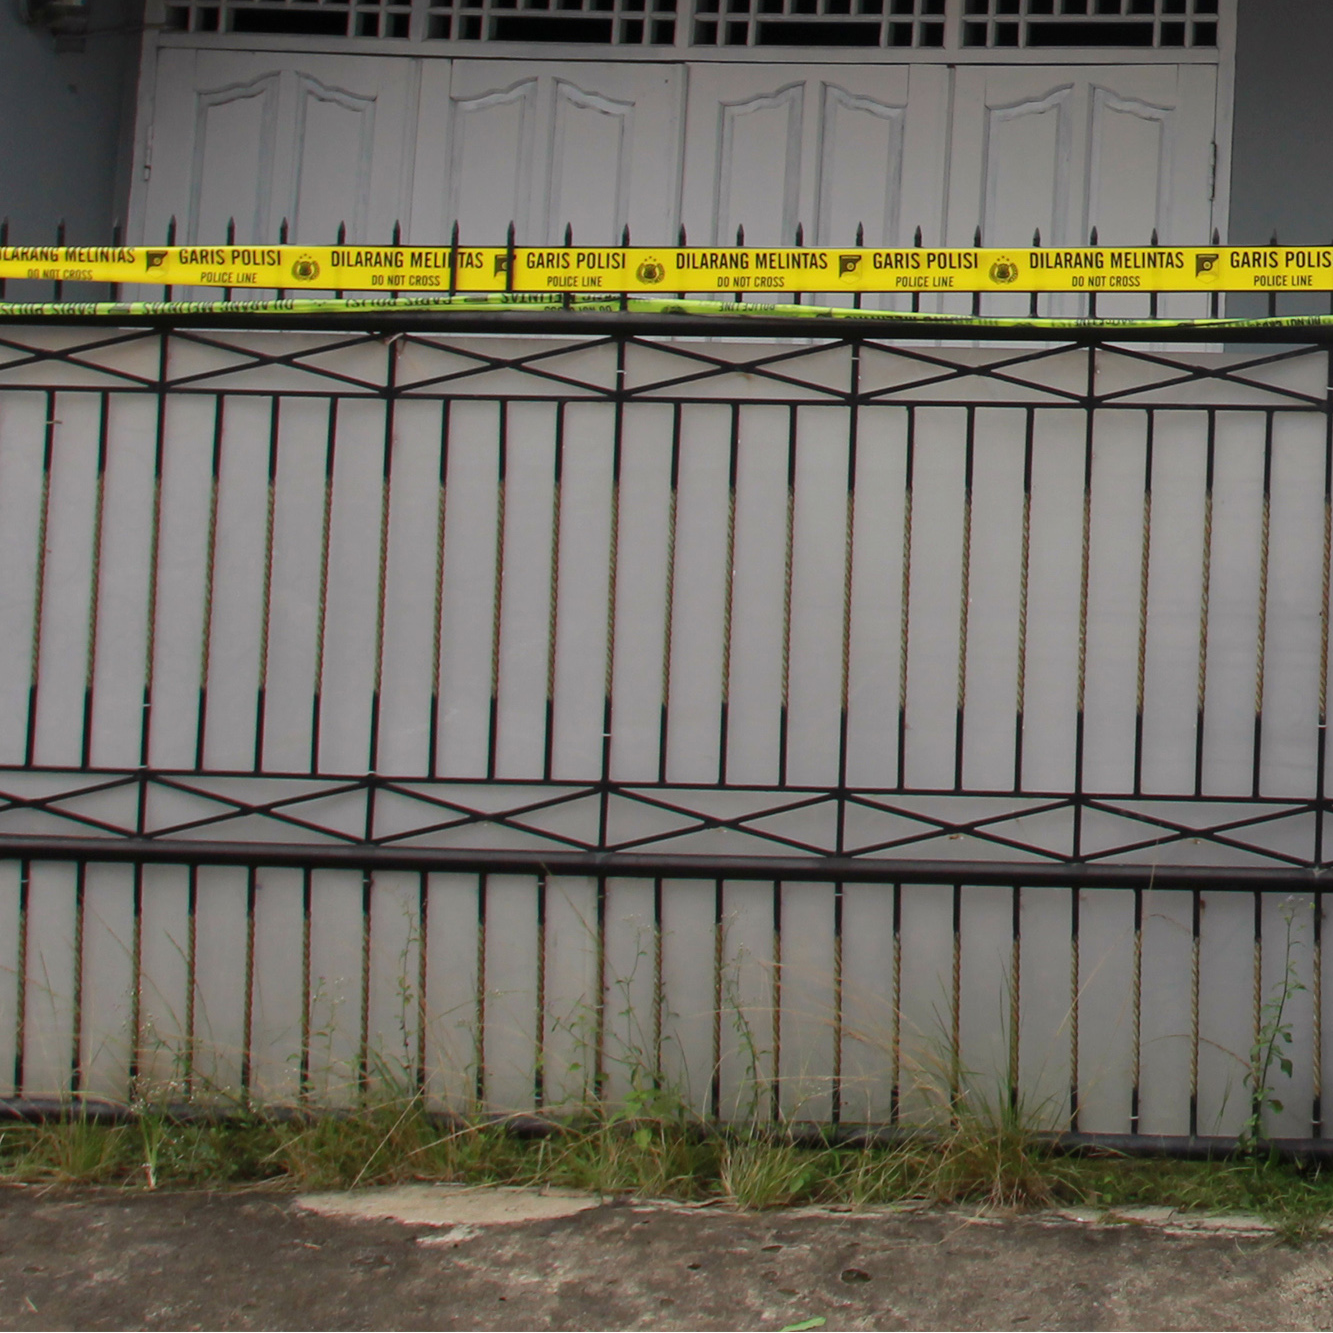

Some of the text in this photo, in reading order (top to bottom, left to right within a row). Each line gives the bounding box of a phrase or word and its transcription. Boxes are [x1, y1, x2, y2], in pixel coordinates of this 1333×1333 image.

[64, 249, 136, 263] MELINTAS
[179, 249, 282, 266] GARIS POLISI
[331, 250, 484, 268] DILARANG MELITAS
[526, 252, 627, 270] GARIS POLISI
[676, 252, 828, 271] DILARANG MELINTAS
[872, 252, 979, 270] GARIS POLISI
[1029, 251, 1185, 269] DILARANG MELINTAS
[1229, 251, 1279, 269] GARIS
[27, 268, 94, 282] DO NOT CROSS
[200, 271, 258, 284] POLICE LINE
[371, 274, 441, 287] DO NOT CROSS
[547, 275, 603, 287] POLICE LINE
[717, 276, 785, 288] DO NOT CROSS
[895, 276, 955, 288] POLICE LINE
[1071, 275, 1141, 288] DO NOT CROSS
[1253, 274, 1313, 287] POLICE LINE
